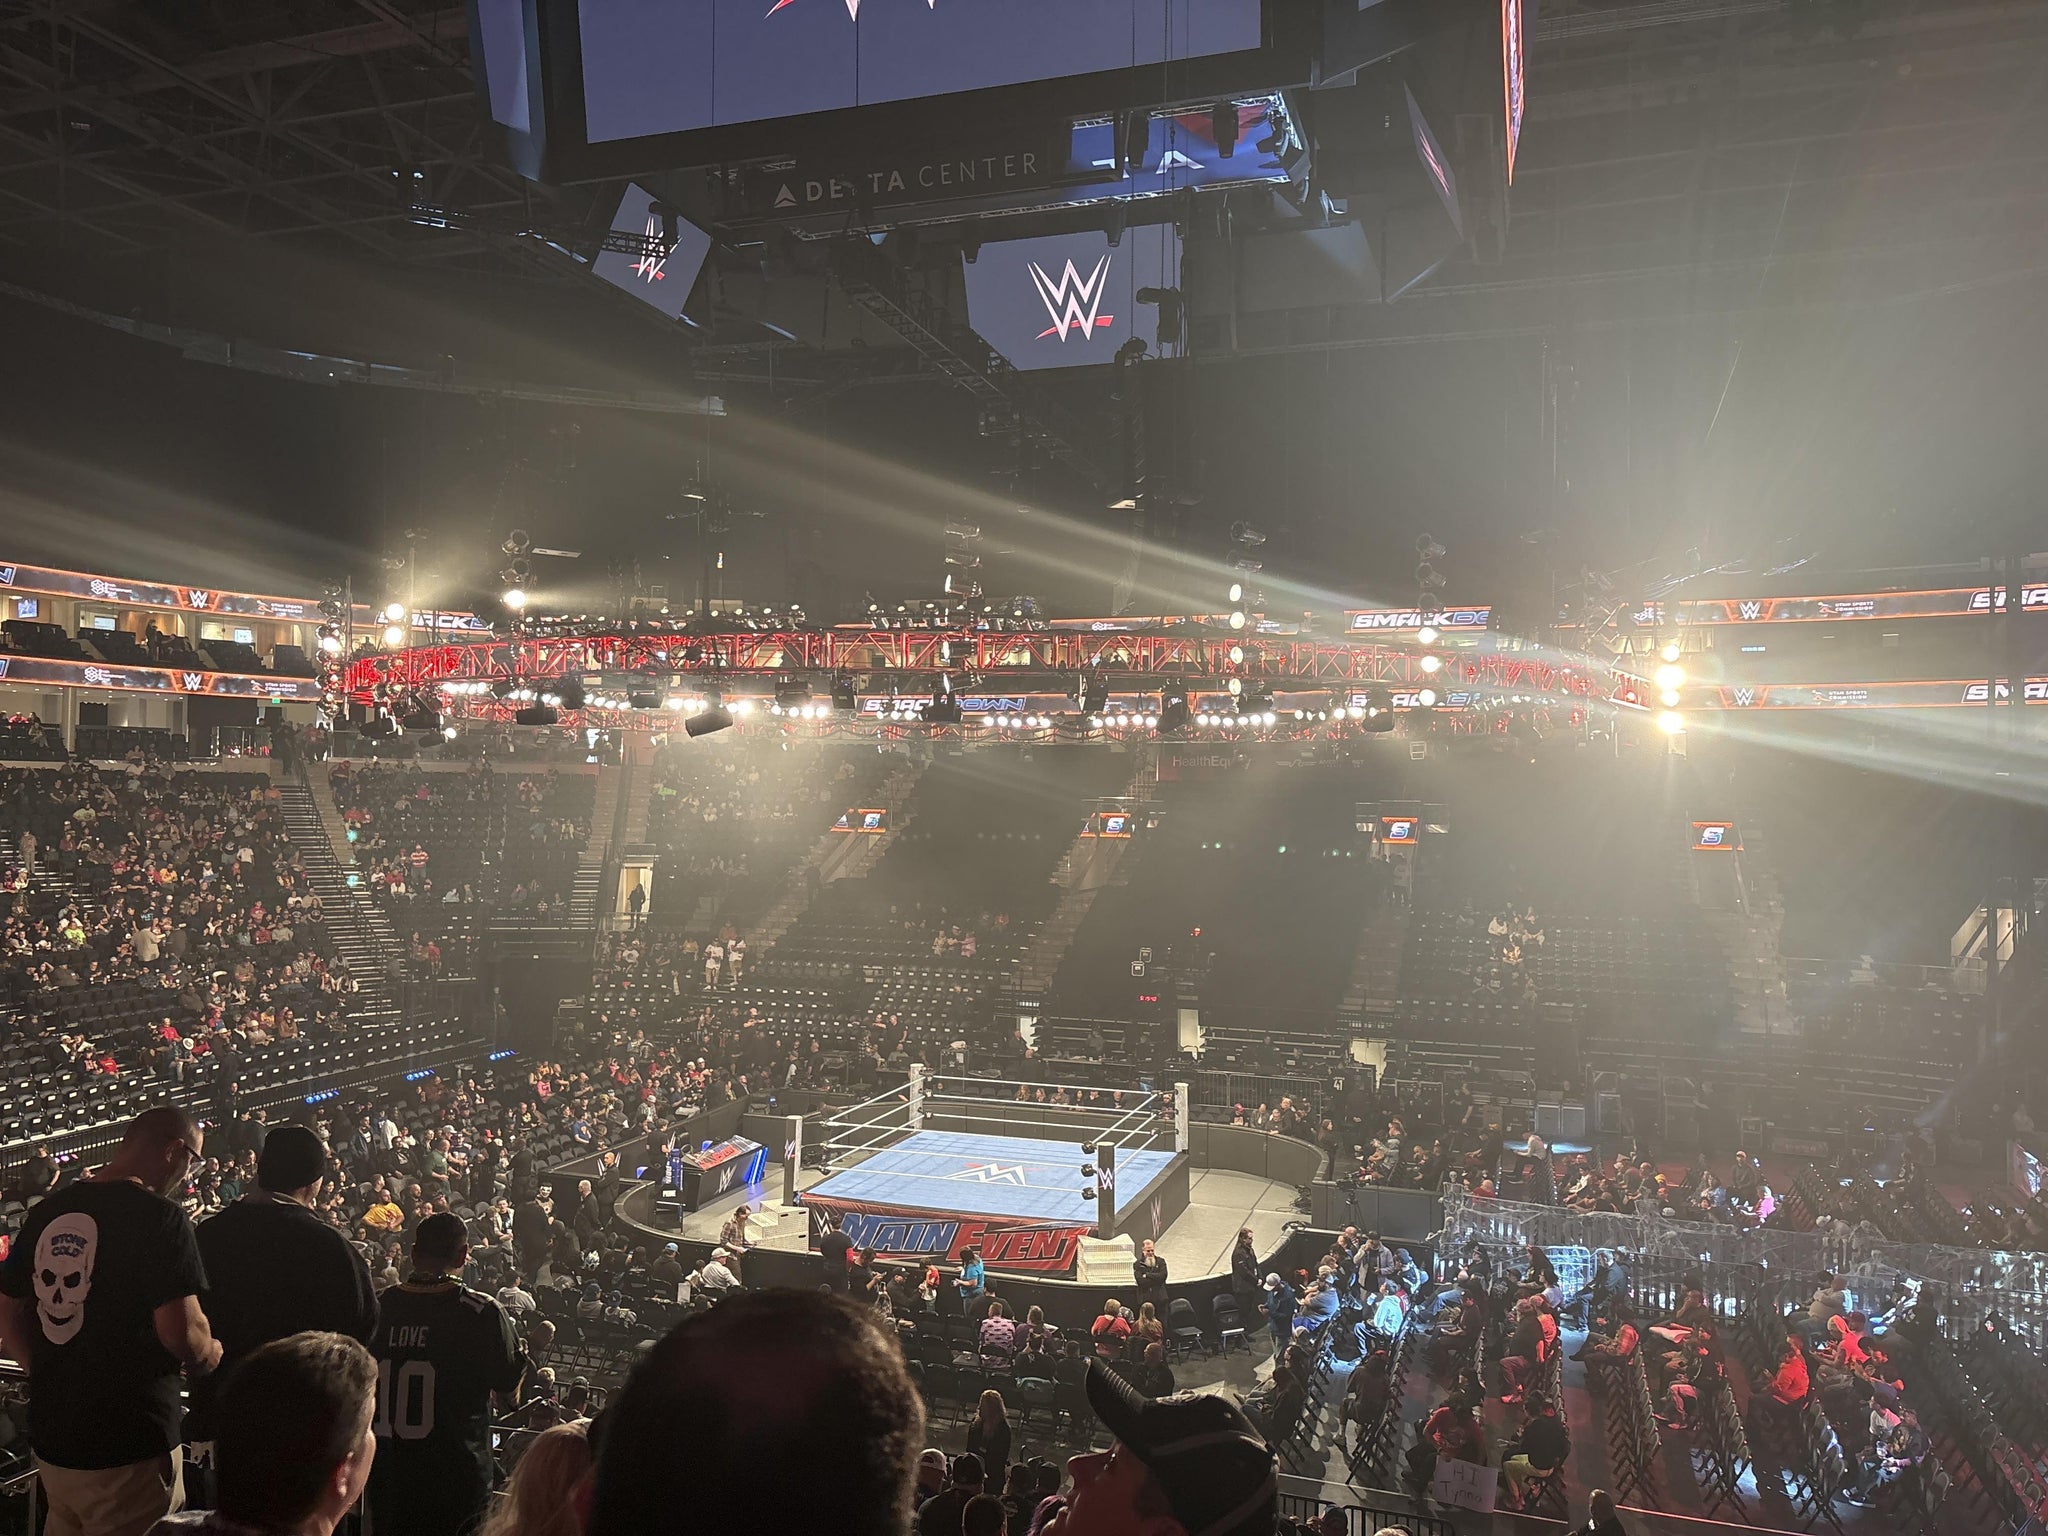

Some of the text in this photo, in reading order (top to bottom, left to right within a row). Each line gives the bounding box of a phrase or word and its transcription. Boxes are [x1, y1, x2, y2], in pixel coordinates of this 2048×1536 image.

[806, 152, 1038, 201] DETA CENTER
[1172, 755, 1252, 770] HealthEqy
[841, 1212, 958, 1252] MAIN
[946, 1223, 1091, 1263] EVENT
[389, 1326, 429, 1347] LOVE
[373, 1359, 436, 1440] 10
